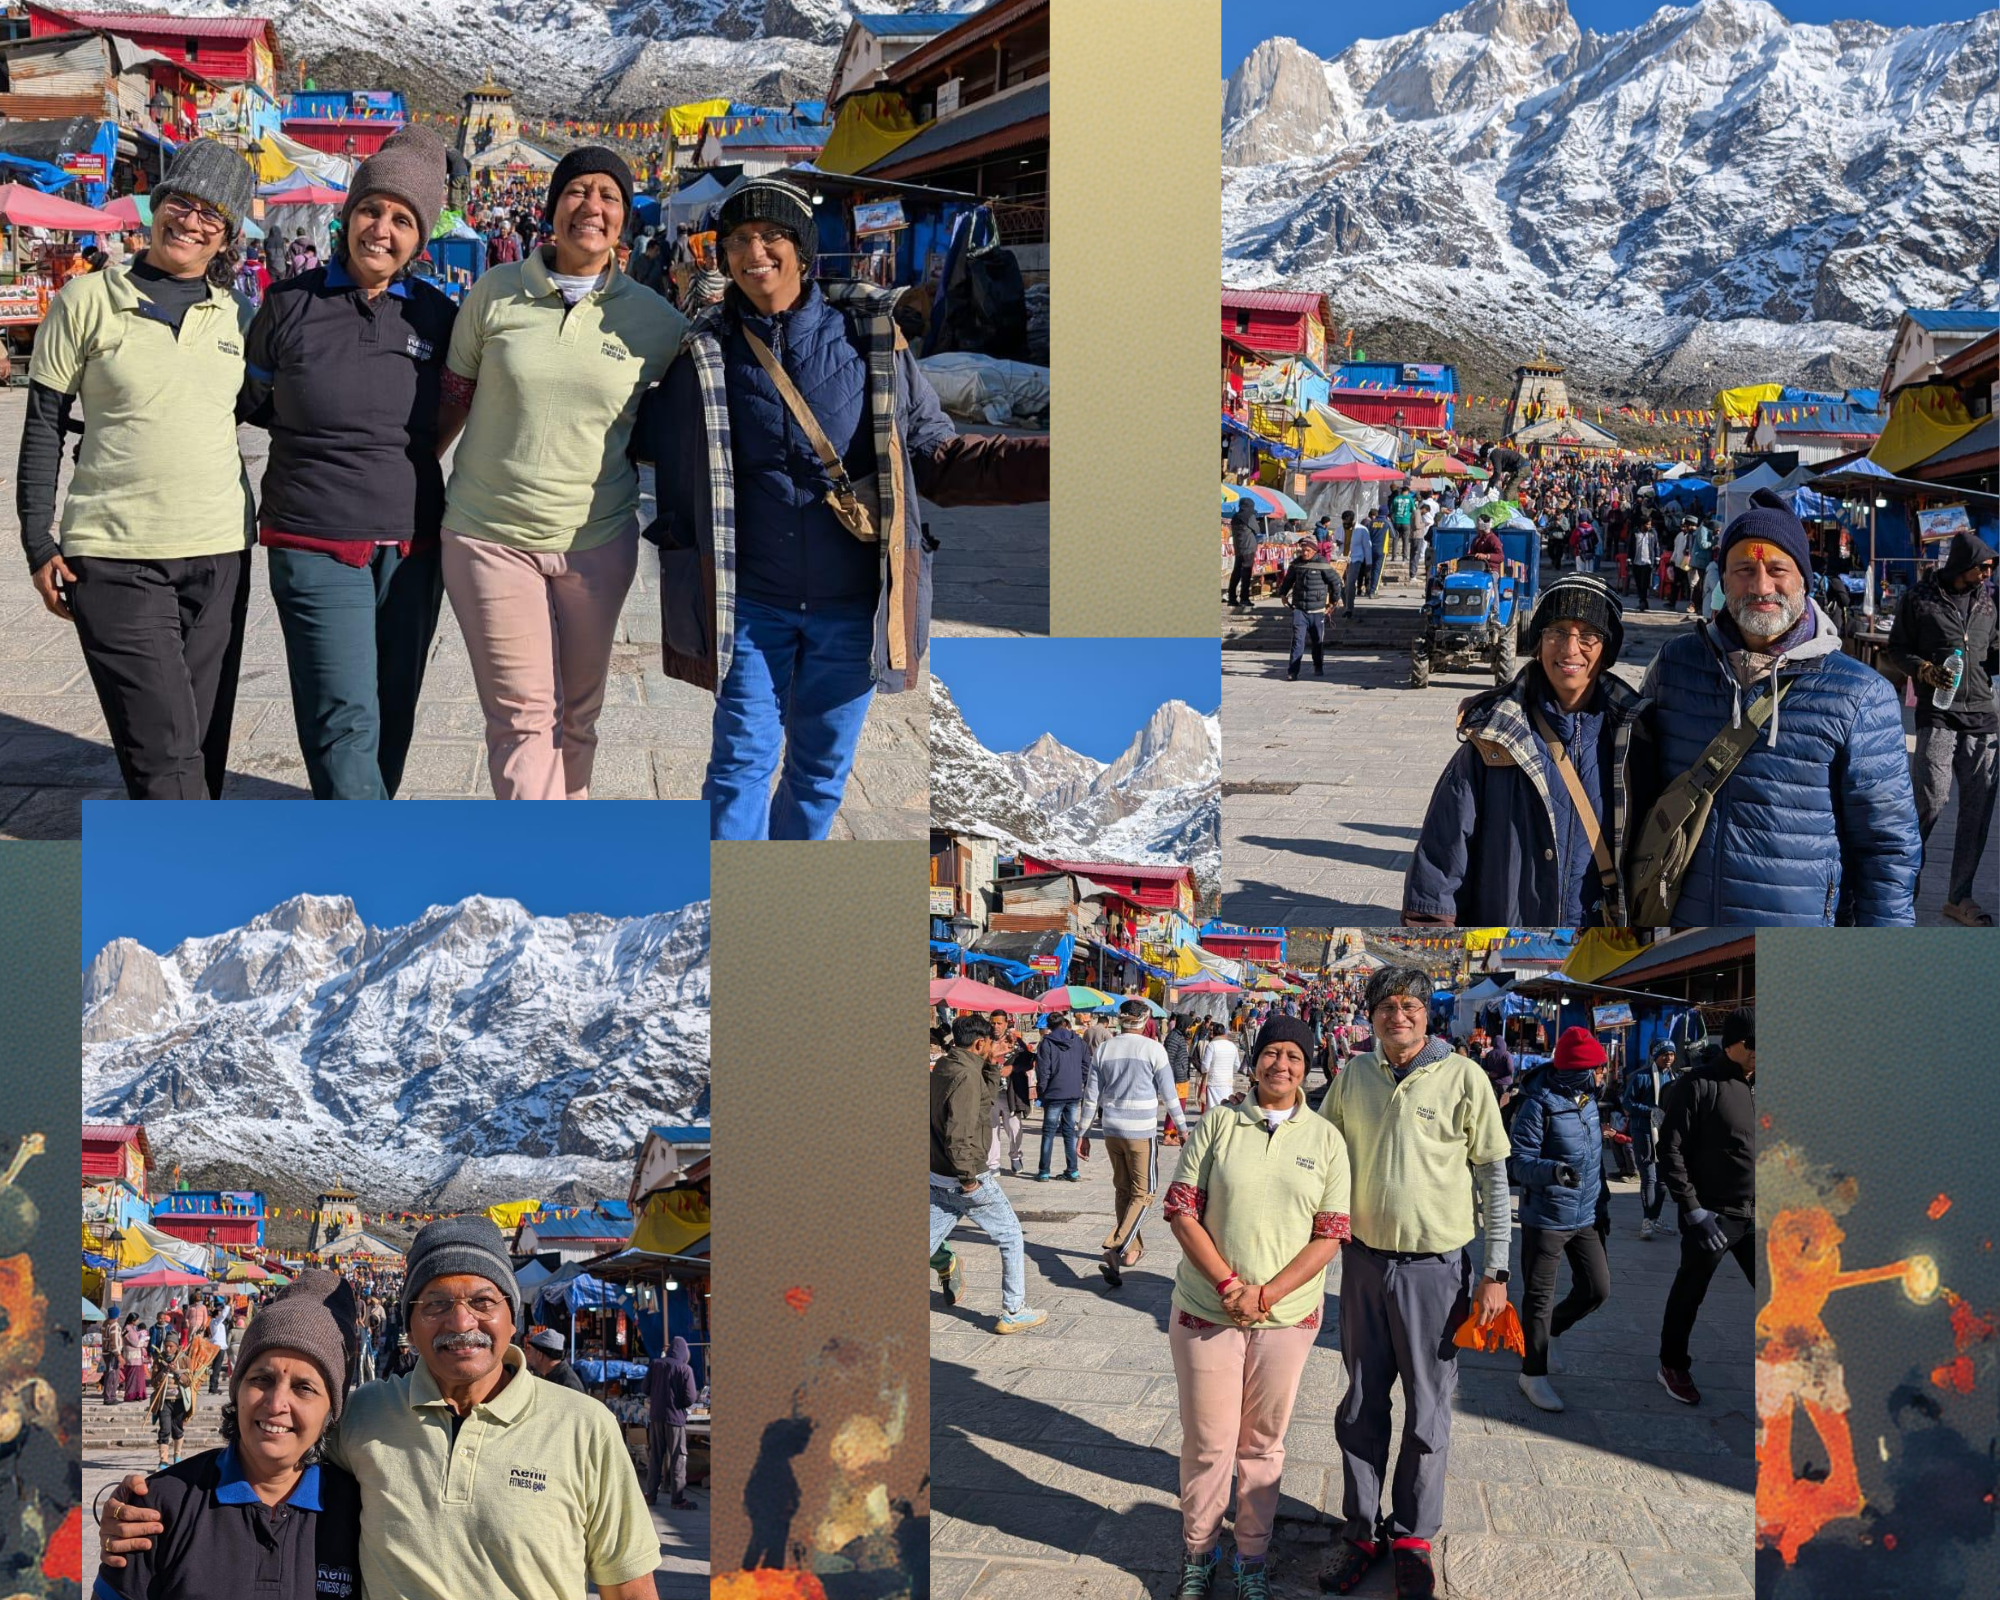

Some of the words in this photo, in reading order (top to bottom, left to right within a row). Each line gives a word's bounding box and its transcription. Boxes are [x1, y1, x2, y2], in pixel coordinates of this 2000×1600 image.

[510, 1465, 547, 1481] Refill
[509, 1477, 532, 1489] FITNESS
[316, 1580, 340, 1594] FITNESS
